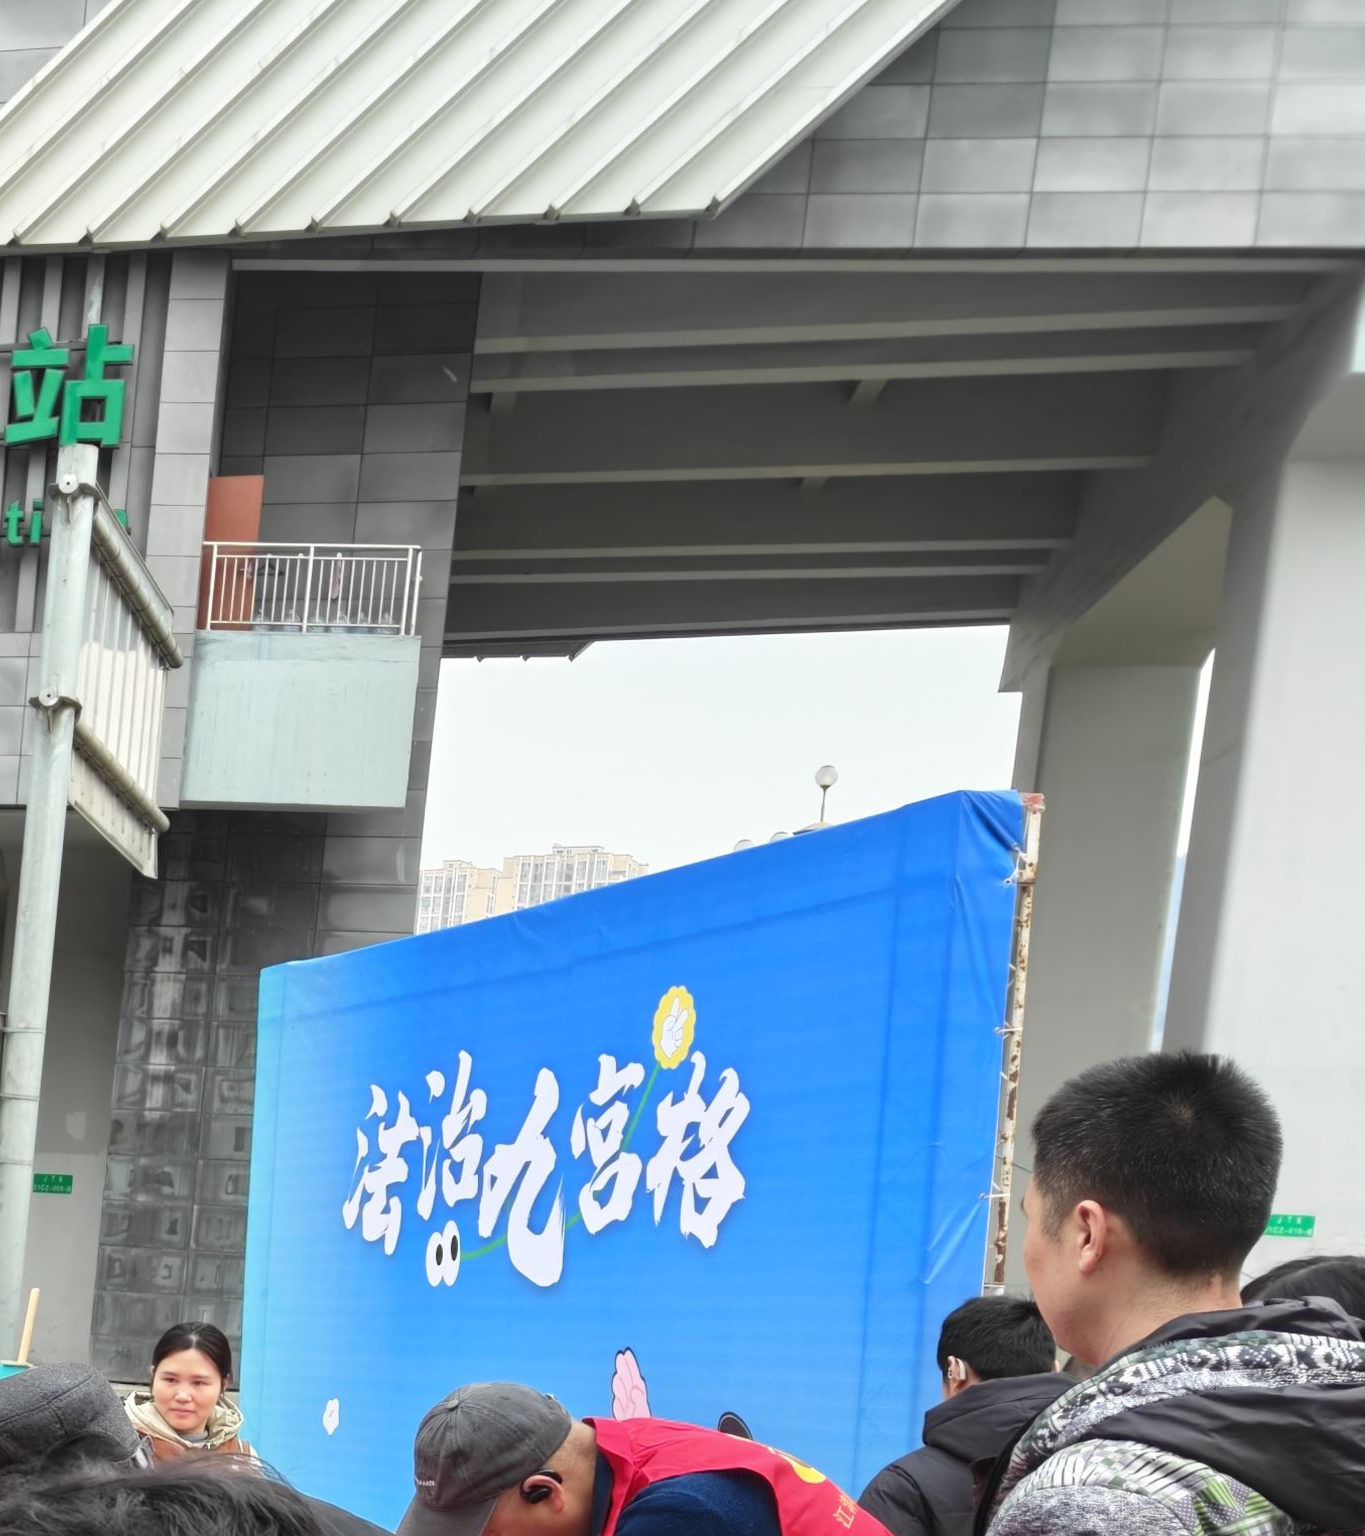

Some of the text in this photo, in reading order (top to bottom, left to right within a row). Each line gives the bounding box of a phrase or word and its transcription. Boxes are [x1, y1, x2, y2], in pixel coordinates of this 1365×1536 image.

[342, 1050, 751, 1288] 法治九宫格
